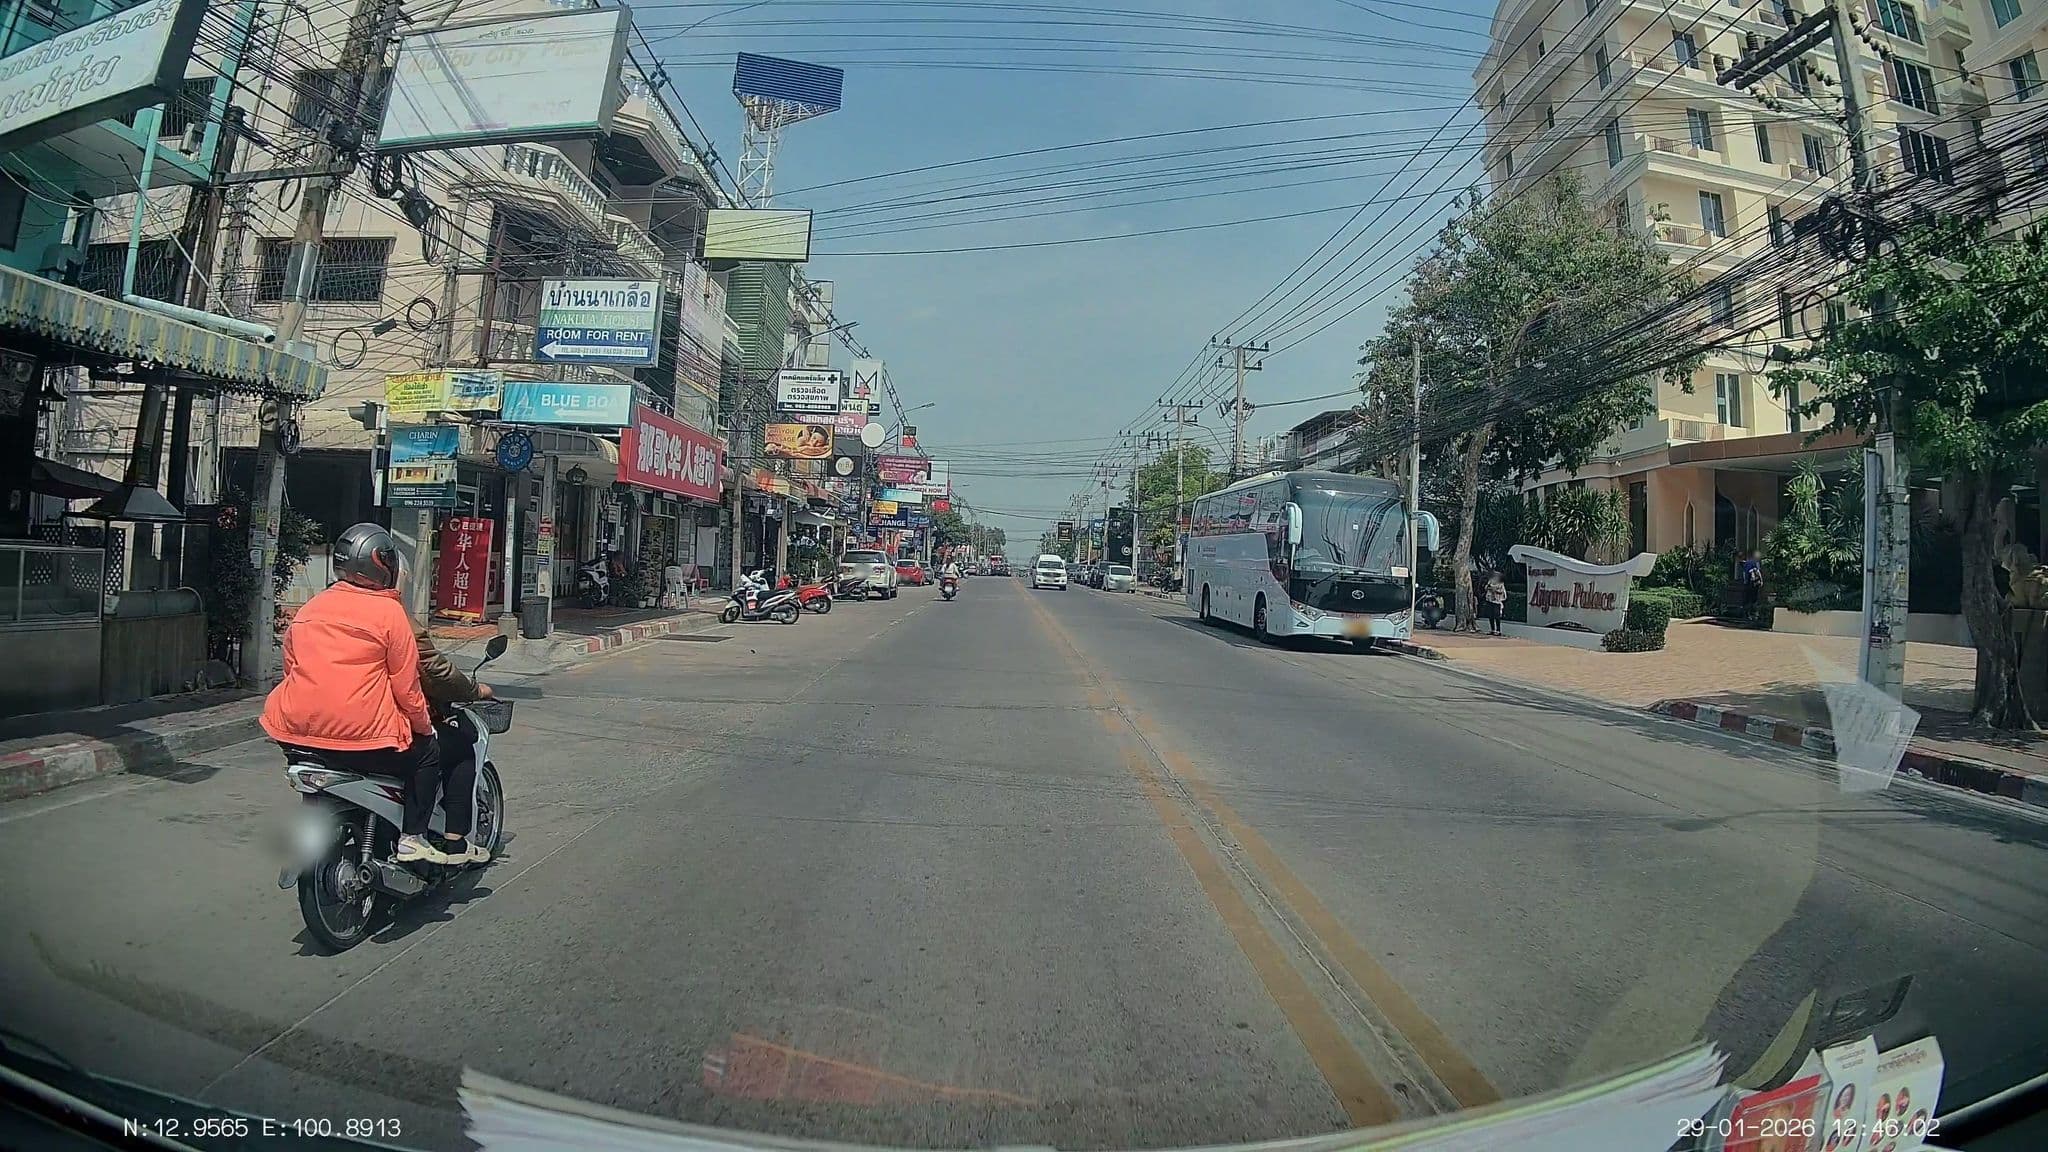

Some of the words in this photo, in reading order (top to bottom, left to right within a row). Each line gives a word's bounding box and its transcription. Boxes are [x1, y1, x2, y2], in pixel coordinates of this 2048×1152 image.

[550, 281, 652, 307] บ้านนาเกลือ
[552, 313, 597, 326] NAKLUA
[546, 329, 581, 340] ROOM
[586, 330, 609, 341] FOR
[615, 331, 646, 341] RENT
[541, 394, 581, 407] BLUE
[409, 431, 438, 440] CHARIN
[452, 533, 473, 608] 华人超市
[1571, 580, 1617, 611] Palace
